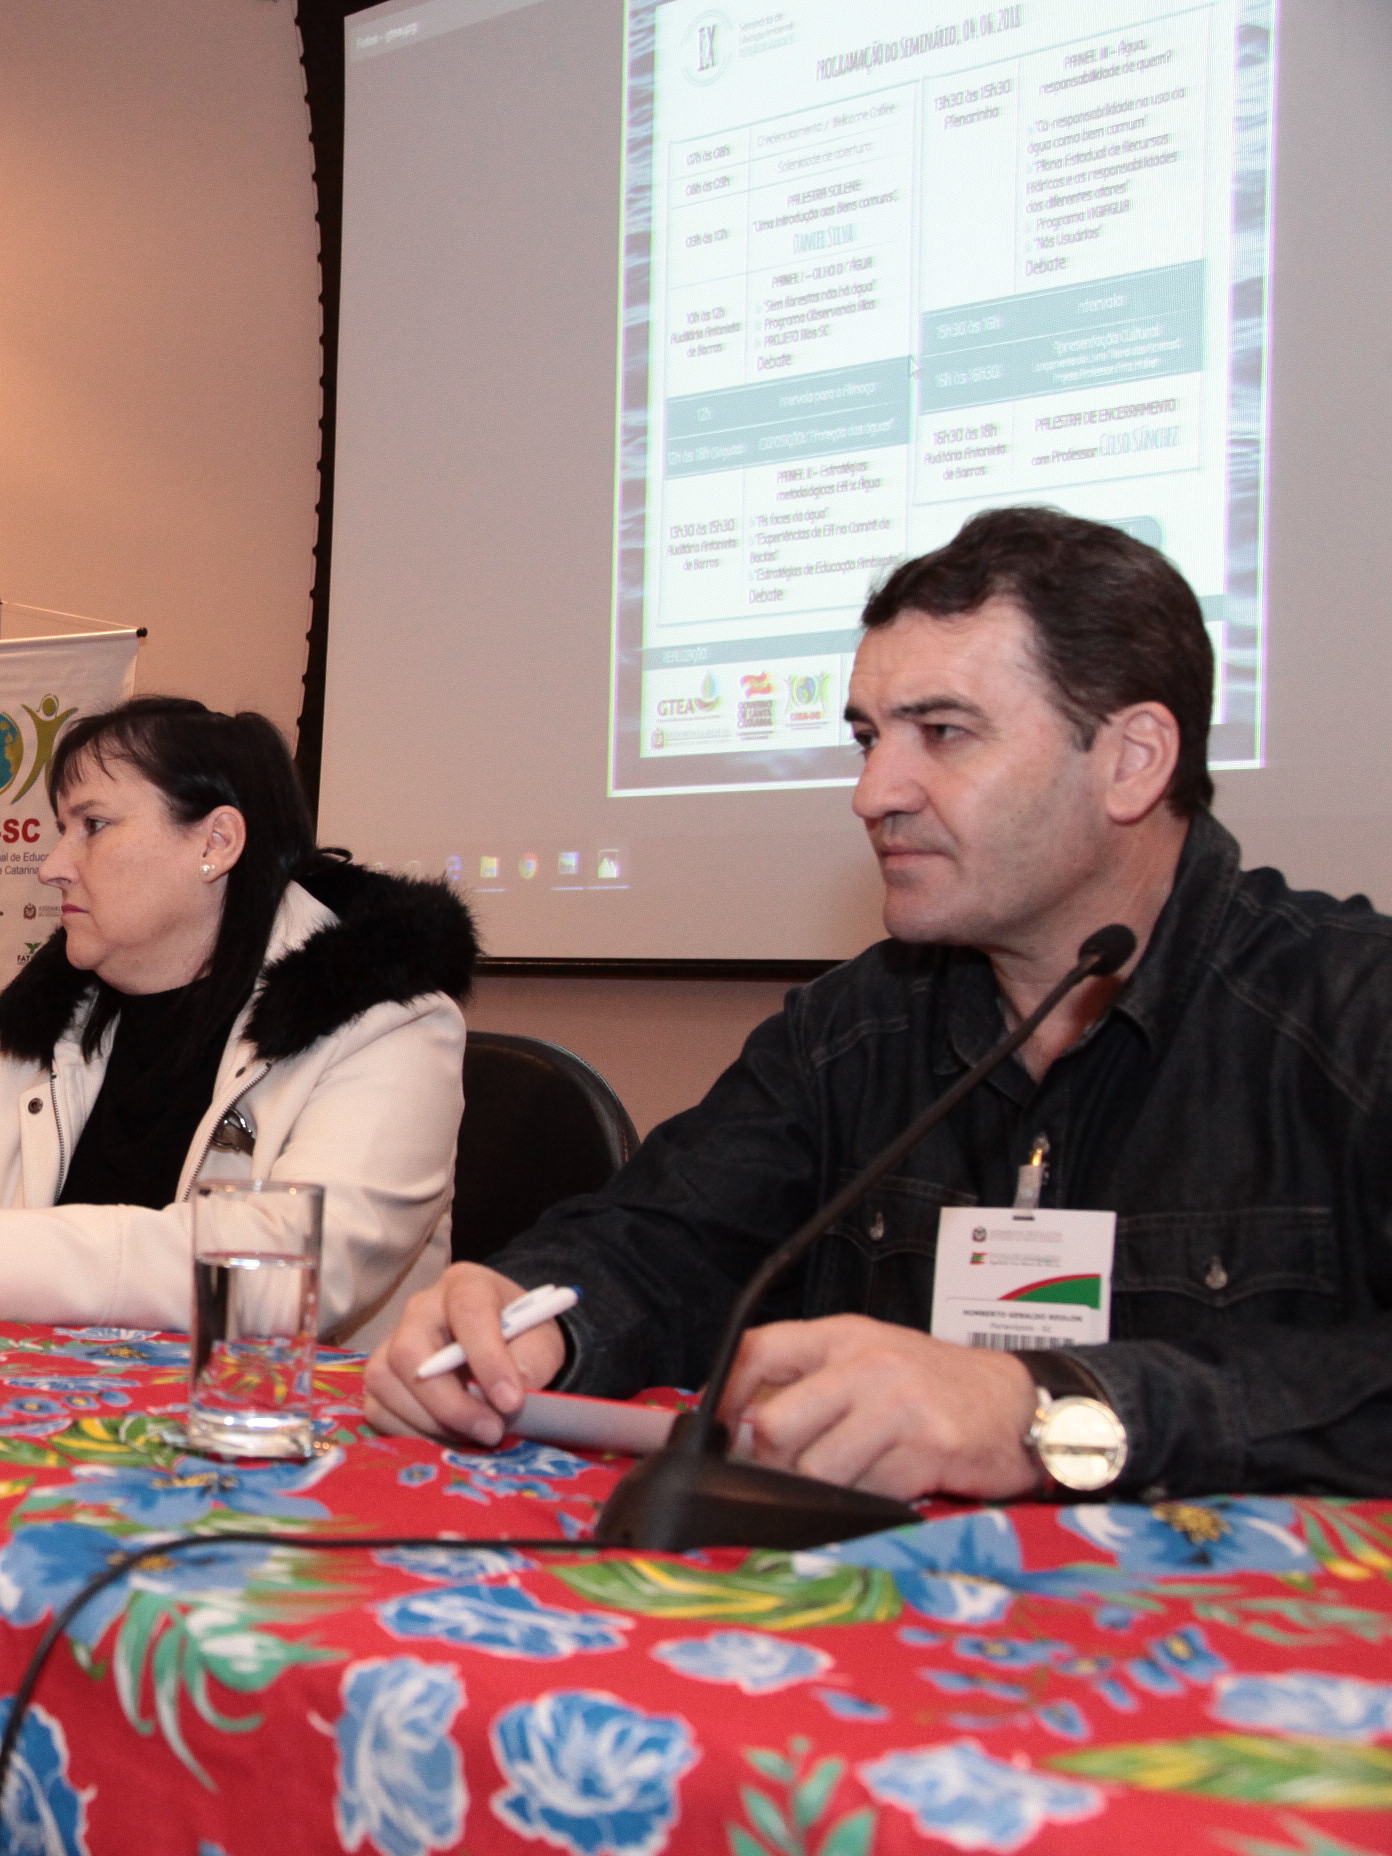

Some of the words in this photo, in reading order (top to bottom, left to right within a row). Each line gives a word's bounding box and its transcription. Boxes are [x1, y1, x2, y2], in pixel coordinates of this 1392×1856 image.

[1025, 253, 1068, 276] Debate
[757, 351, 793, 371] Debate
[749, 587, 784, 605] Debate
[657, 698, 696, 717] GTEA
[10, 852, 21, 862] de
